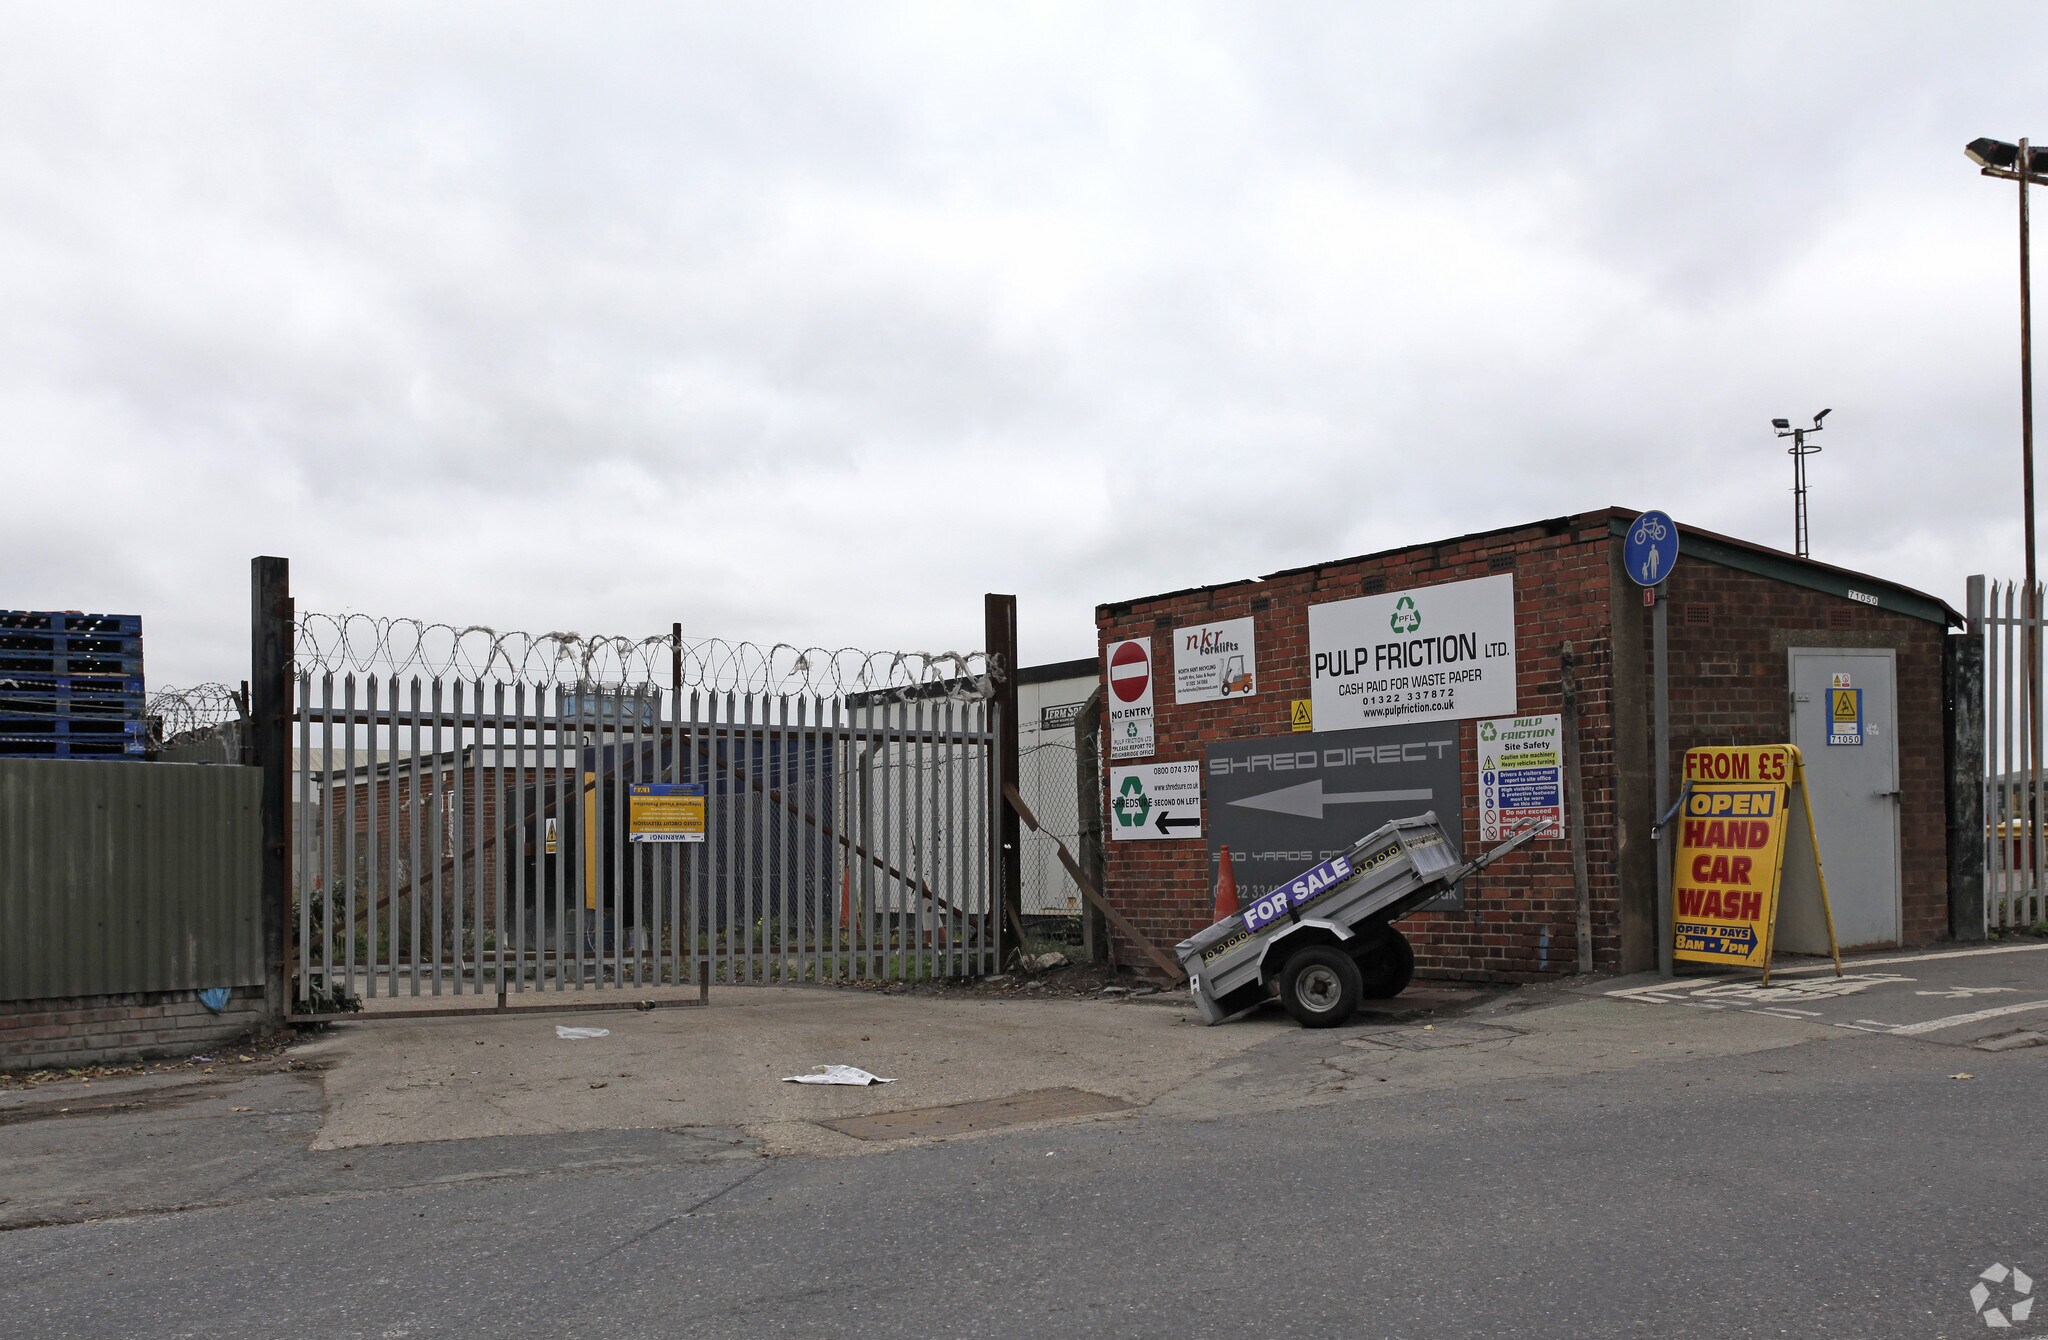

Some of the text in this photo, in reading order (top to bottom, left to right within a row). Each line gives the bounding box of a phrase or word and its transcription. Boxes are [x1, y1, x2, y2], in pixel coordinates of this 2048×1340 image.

[1647, 592, 1650, 602] 1
[1850, 591, 1877, 605] 71050
[1398, 614, 1415, 623] PFL
[1186, 628, 1223, 650] nkr
[1315, 632, 1510, 679] PULP FRICTION LTD.
[1338, 669, 1482, 696] CASH PAID FOR WASTE PAPER
[1363, 688, 1454, 706] 01322 337872
[1112, 707, 1151, 719] NO ENTRY
[1364, 700, 1454, 718] www.pulpfriction.co.uk
[1514, 718, 1542, 727] PULP
[1501, 728, 1555, 740] FRICTION
[1523, 741, 1550, 749] Safety
[1210, 740, 1452, 775] SHRED DIRECT
[1154, 765, 1198, 775] 0800 074 3707
[1686, 753, 1786, 780] FROM £5
[1154, 782, 1199, 791] www.shredsure.co.uk
[1112, 798, 1152, 808] SHREDSURE
[1690, 794, 1772, 815] OPEN
[1683, 820, 1770, 850] HAND
[1252, 851, 1312, 861] YARDS
[1692, 854, 1752, 885] CAR
[1244, 856, 1350, 929] FOR SALE
[1678, 888, 1763, 921] WASH
[1677, 925, 1707, 935] OPEN
[1720, 928, 1748, 938] DAYS
